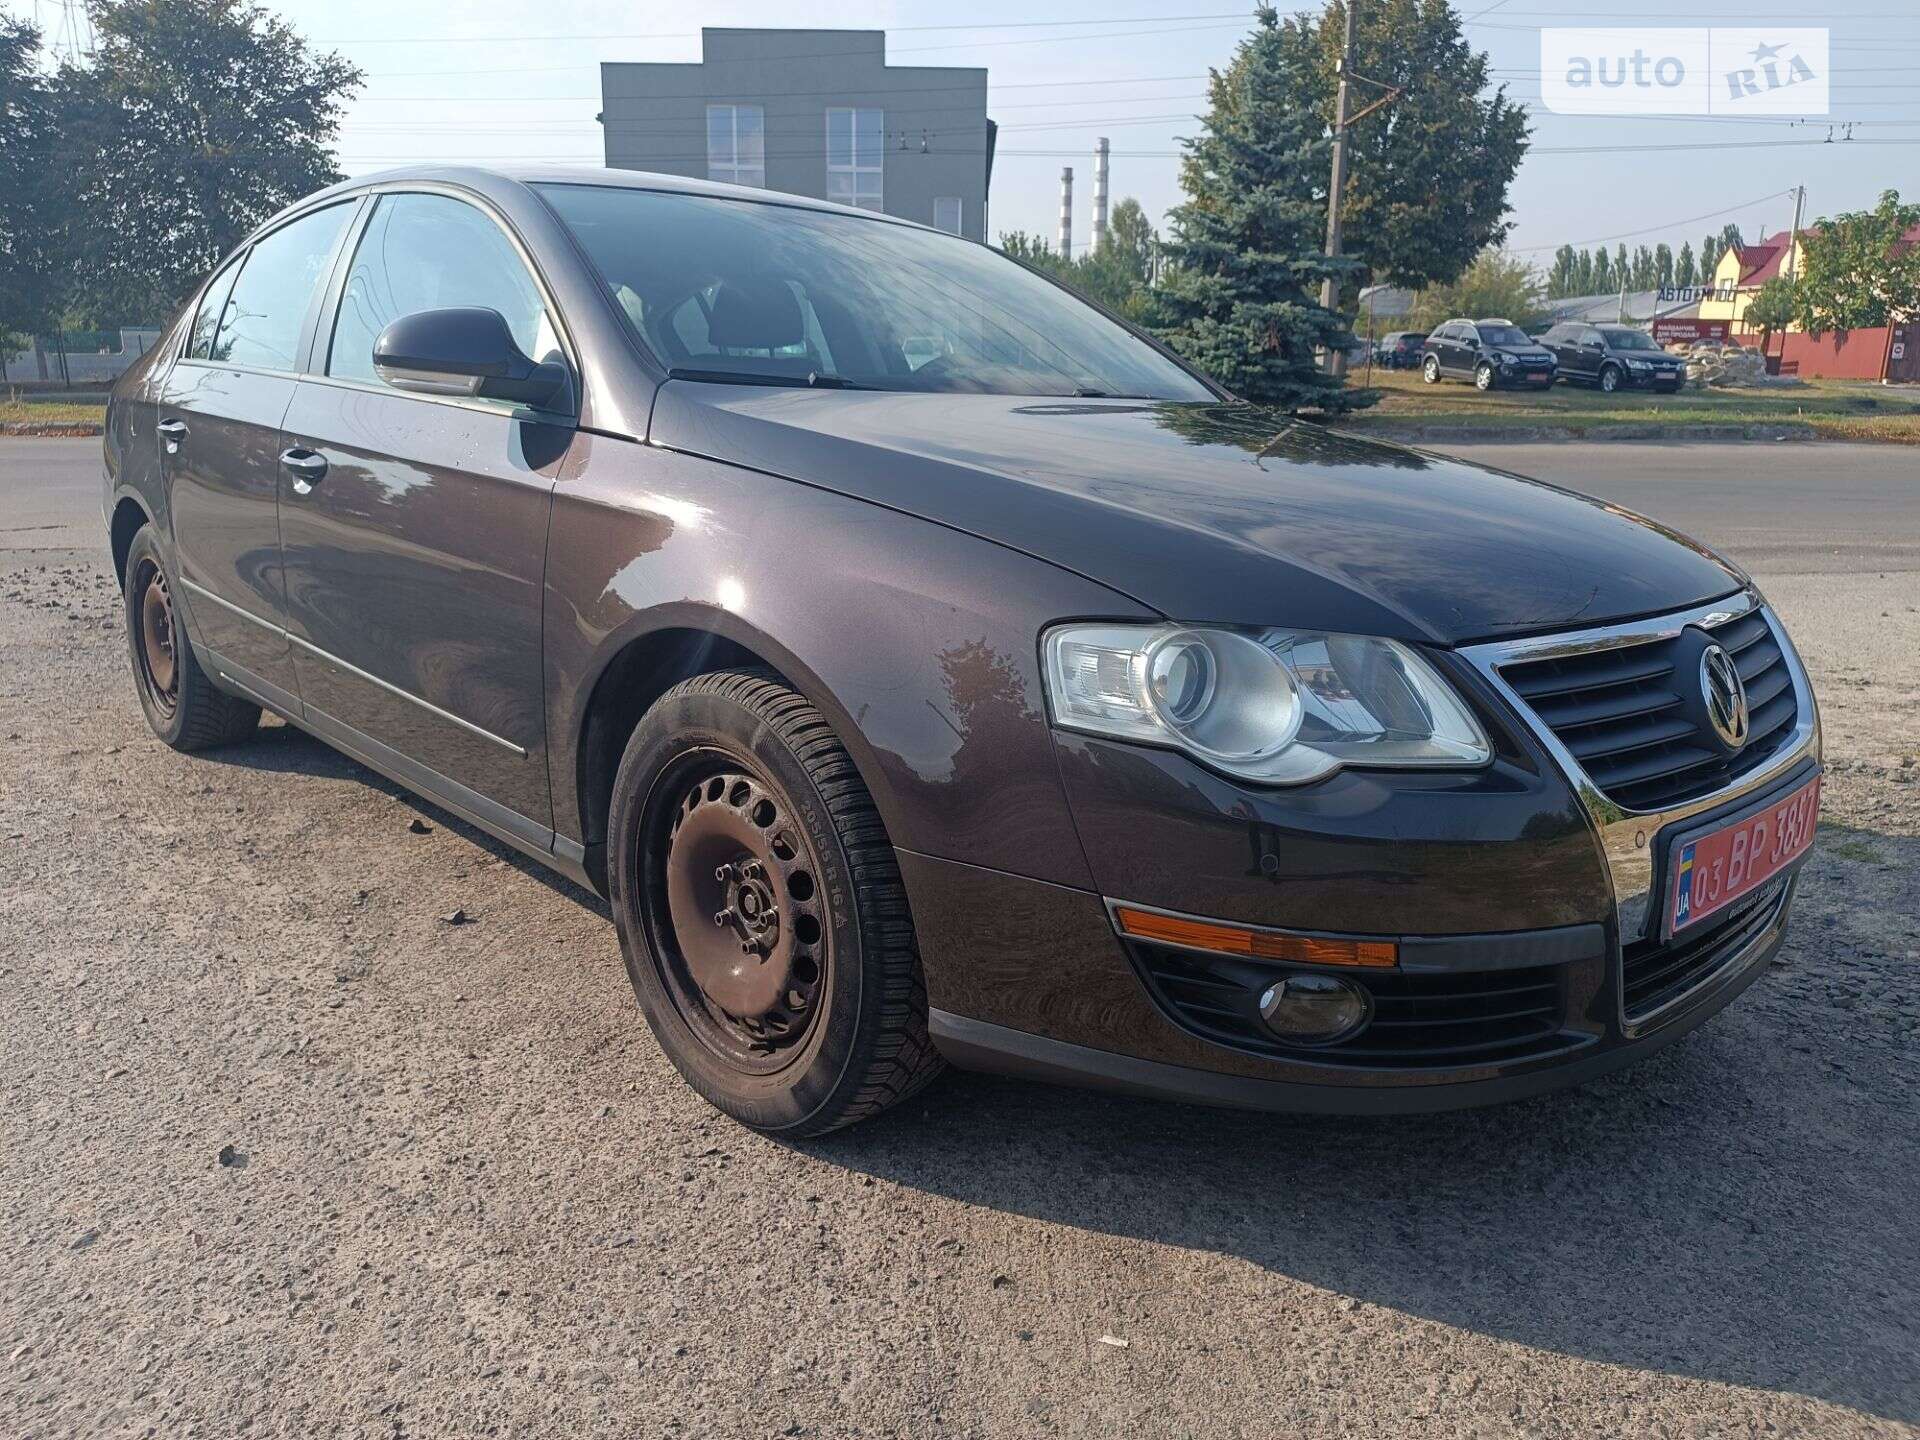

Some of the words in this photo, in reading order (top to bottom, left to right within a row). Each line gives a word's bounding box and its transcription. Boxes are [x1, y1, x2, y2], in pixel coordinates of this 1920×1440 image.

[1695, 856, 1724, 909] 03
[1727, 821, 1768, 891] BP
[1771, 788, 1816, 864] 3857
[1676, 892, 1690, 917] UA
